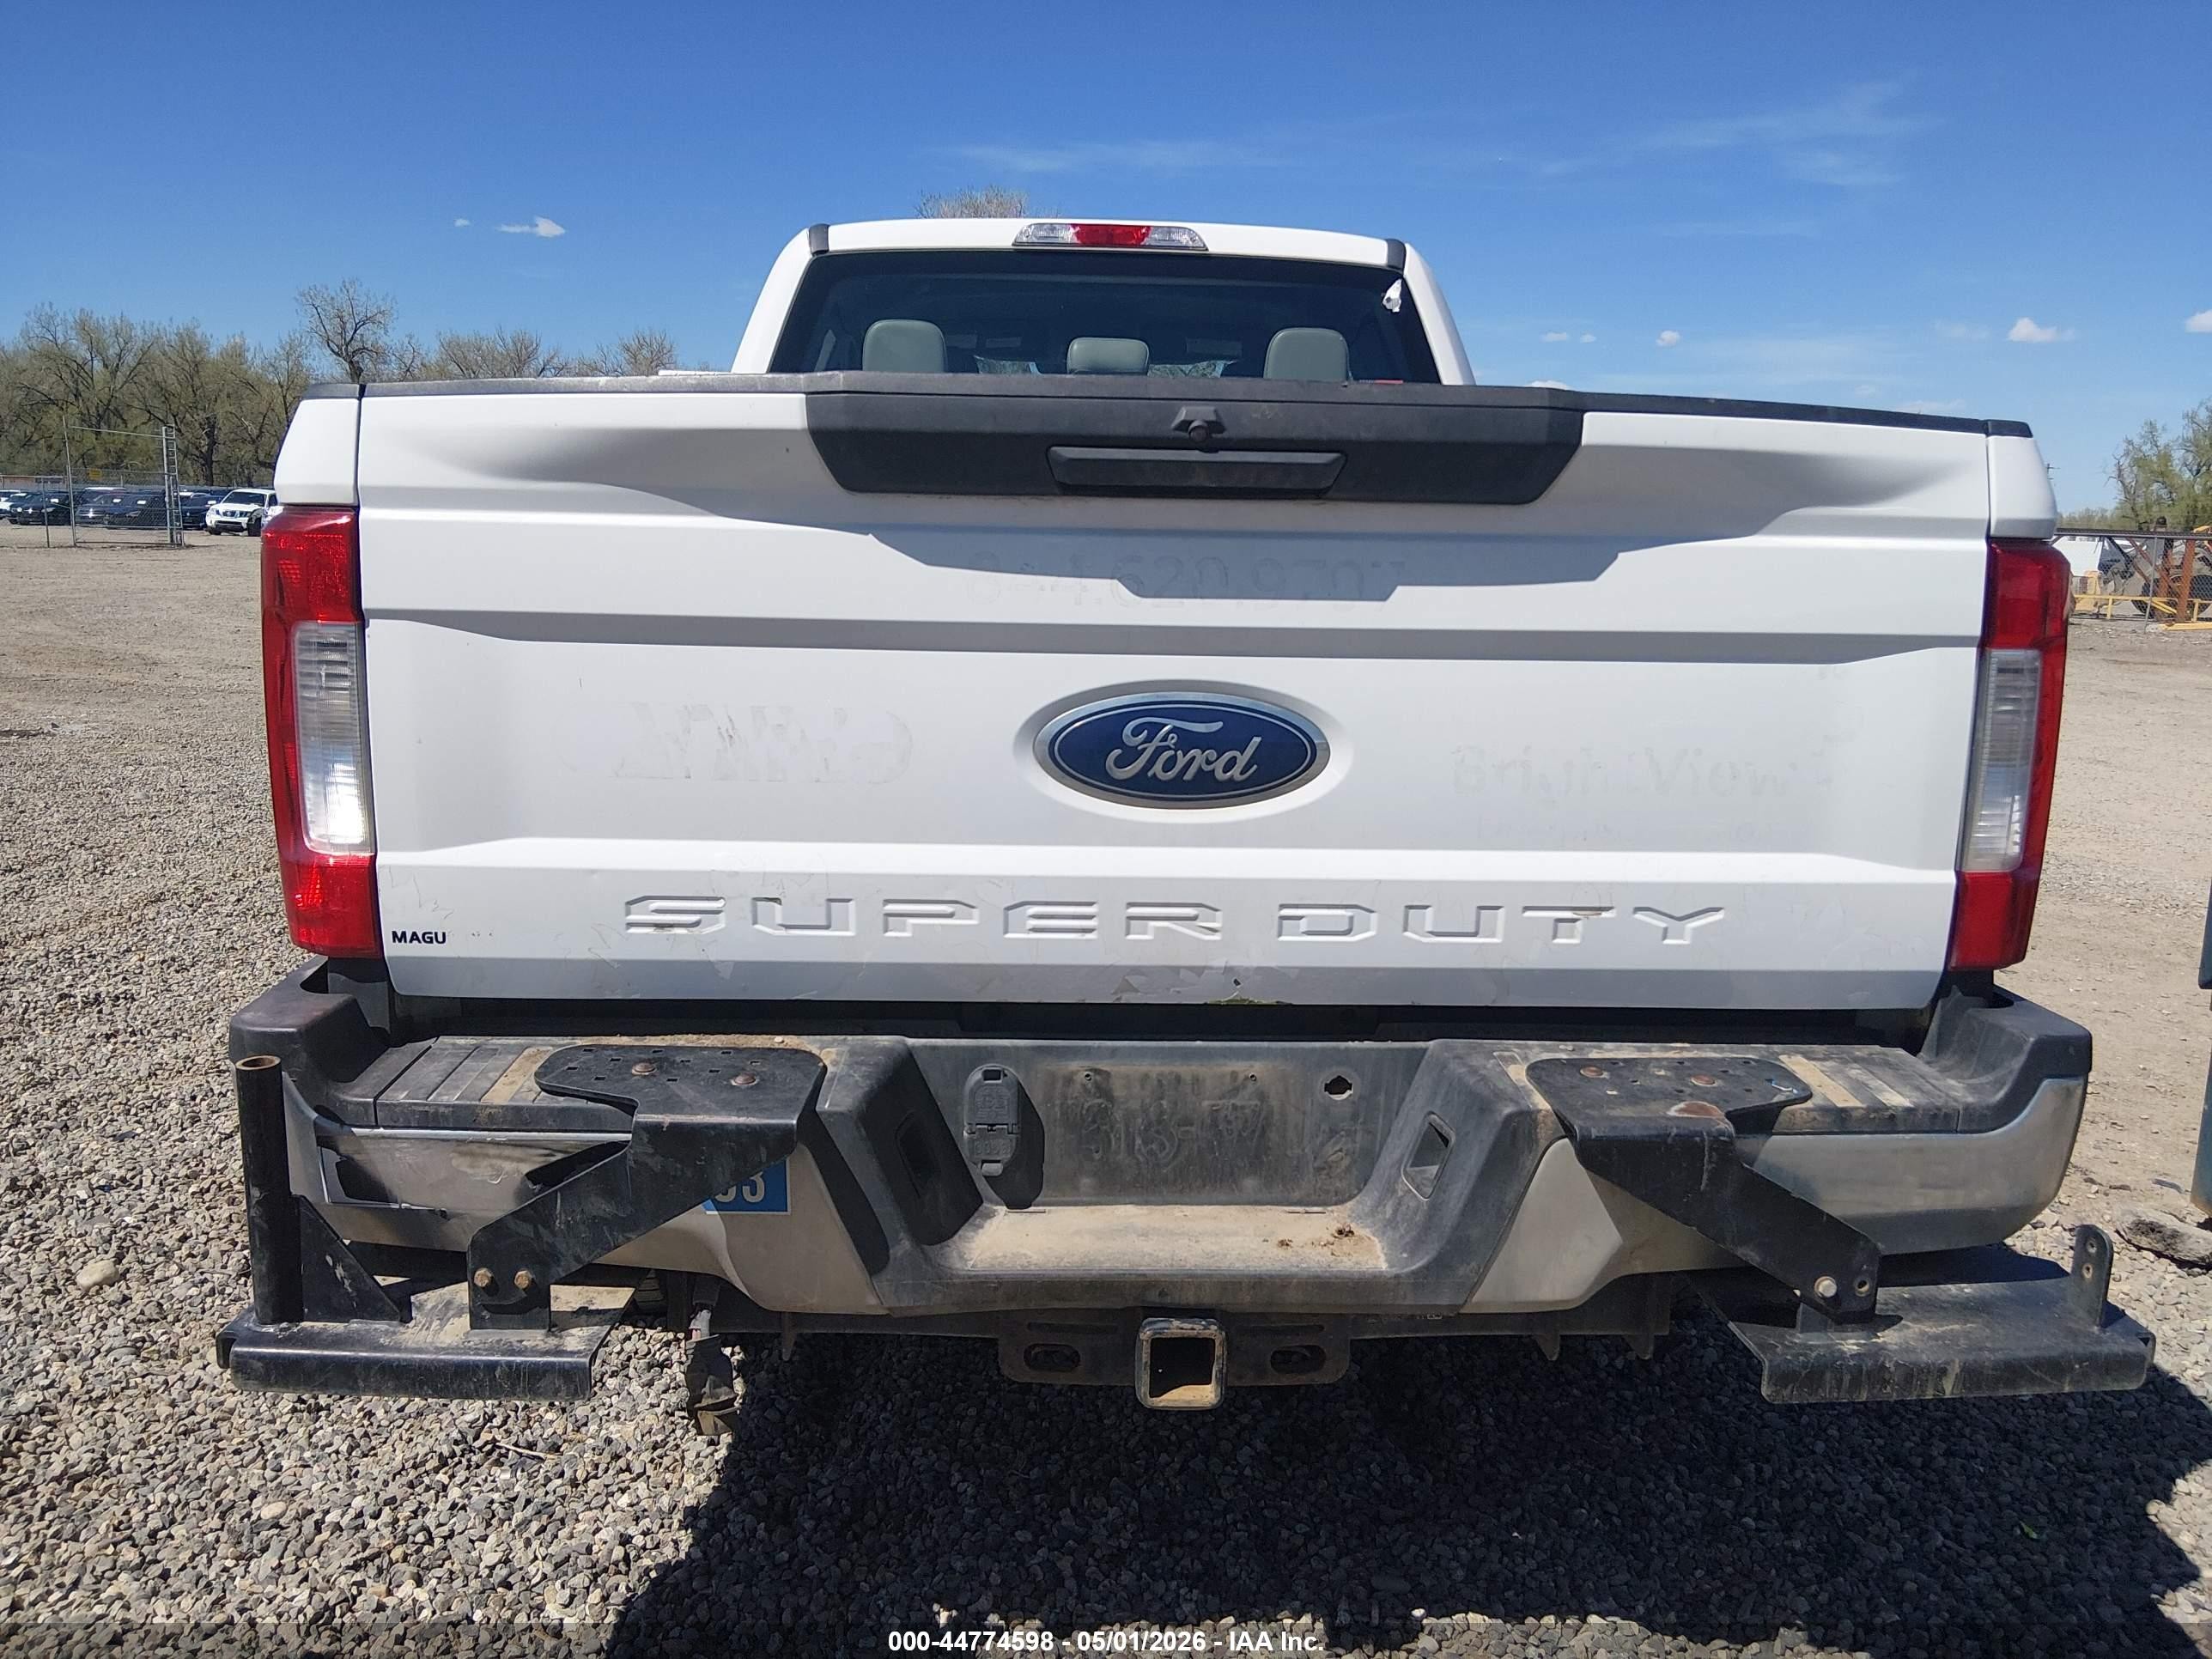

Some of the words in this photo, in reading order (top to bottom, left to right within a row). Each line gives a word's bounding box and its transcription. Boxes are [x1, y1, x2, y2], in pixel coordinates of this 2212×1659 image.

[1105, 716, 1262, 781] Ford
[392, 930, 447, 945] MAGU
[625, 896, 1223, 940] SUPER
[1277, 903, 1725, 944] DUTY
